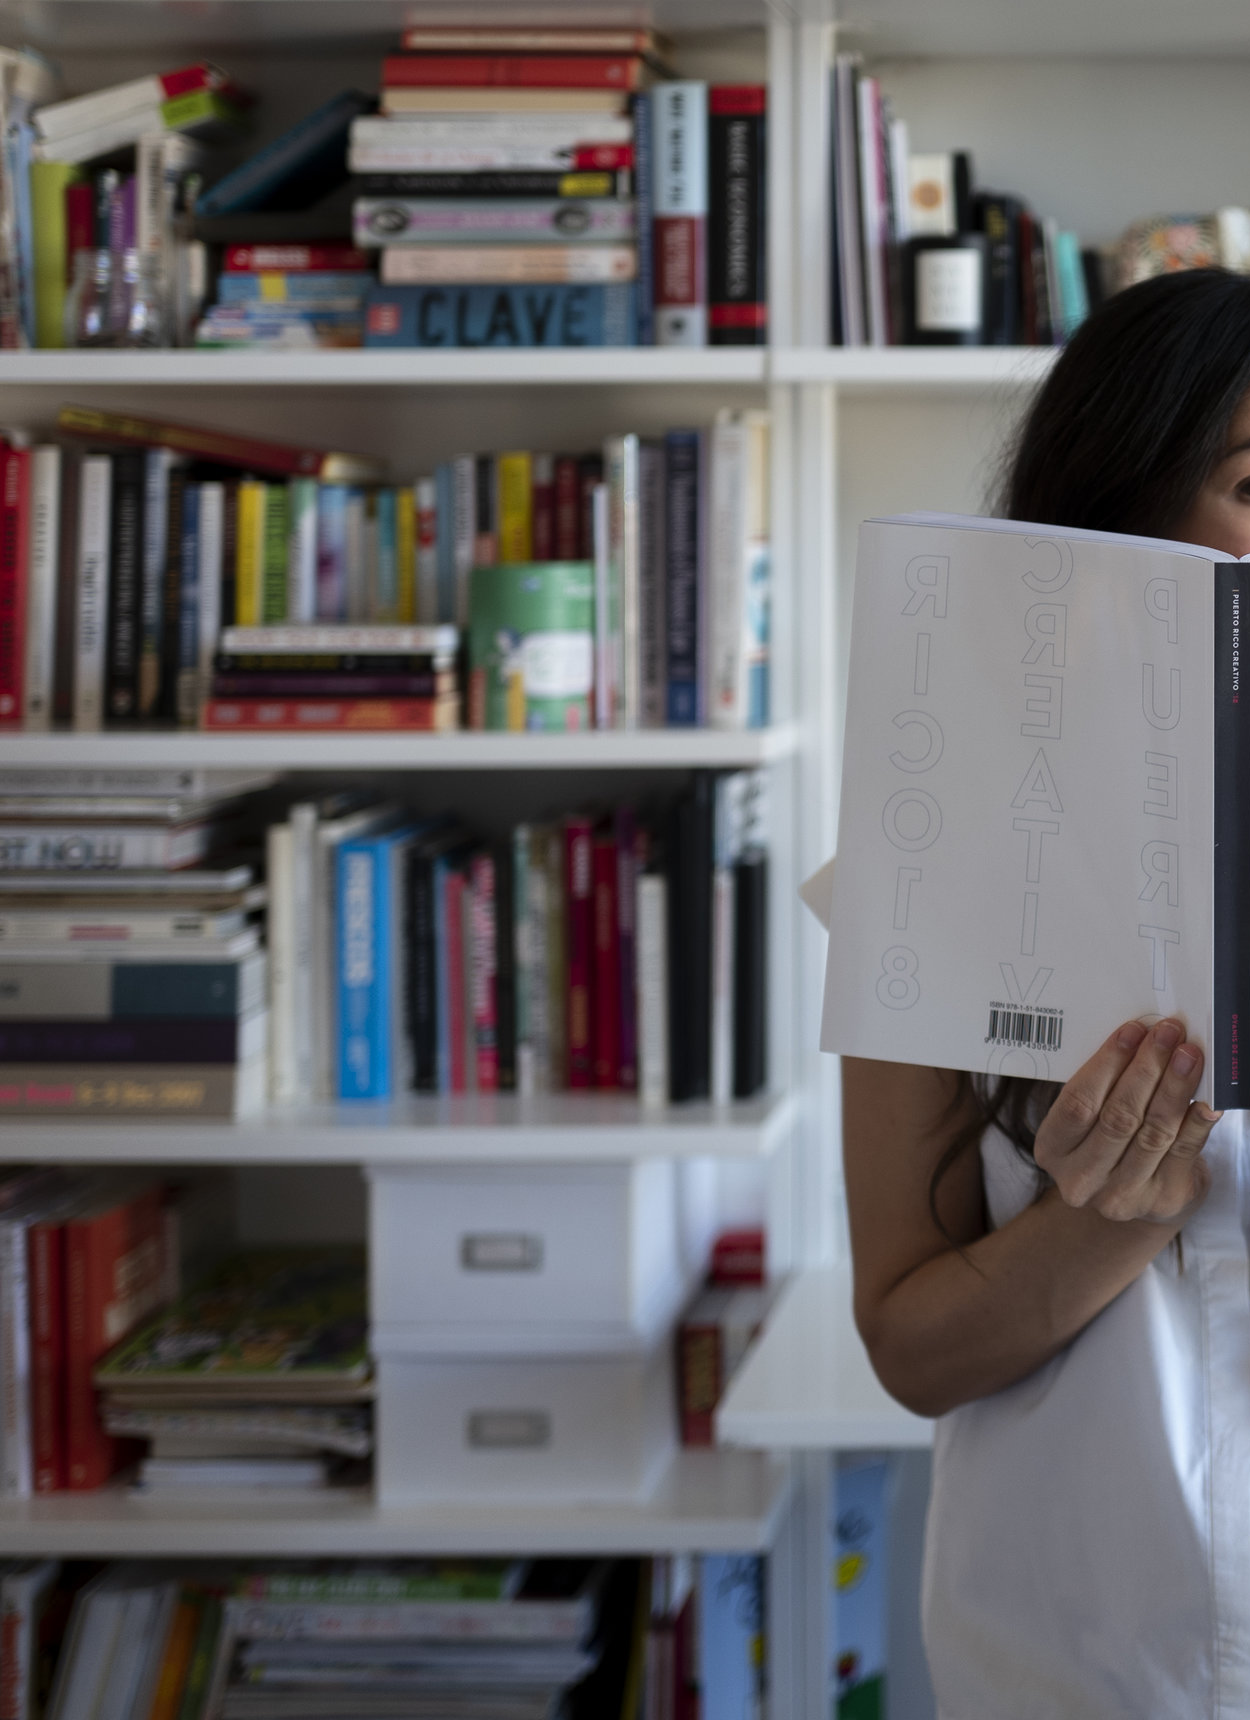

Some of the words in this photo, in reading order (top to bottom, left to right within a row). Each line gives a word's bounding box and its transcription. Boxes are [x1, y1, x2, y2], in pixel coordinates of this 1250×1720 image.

[417, 290, 590, 346] CLAVE
[1232, 594, 1240, 626] PUERTO
[1232, 628, 1240, 648] RICO
[1232, 650, 1240, 691] CREATIVO
[38, 836, 124, 869] NOW
[989, 1001, 1005, 1009] ISBN
[1232, 1044, 1239, 1054] DE
